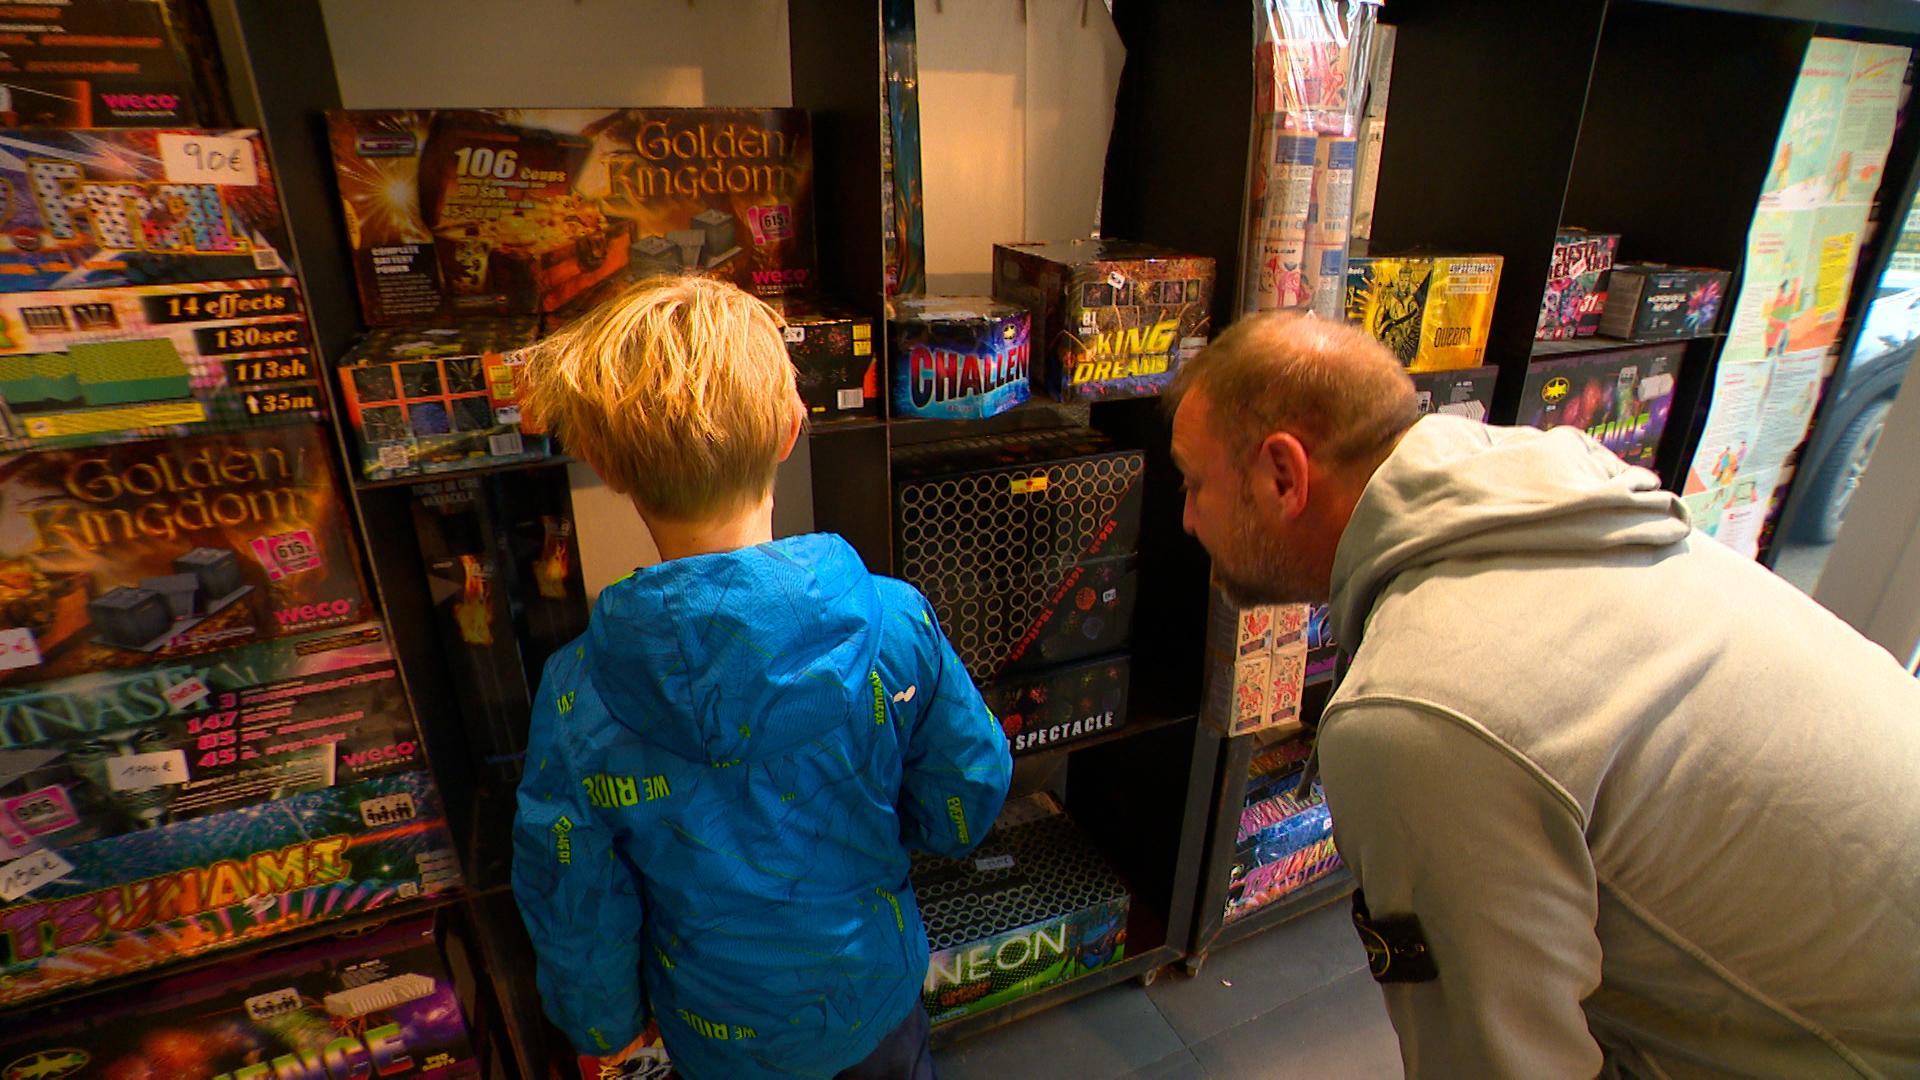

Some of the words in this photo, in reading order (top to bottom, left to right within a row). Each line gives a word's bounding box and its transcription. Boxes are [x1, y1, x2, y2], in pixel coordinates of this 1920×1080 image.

[635, 120, 786, 160] Golden
[454, 147, 518, 179] 106
[168, 297, 199, 318] 14
[205, 292, 286, 319] effects
[215, 327, 299, 349] 130sec
[1096, 317, 1183, 356] KING
[234, 358, 308, 383] 113sh
[65, 446, 293, 502] Golden
[273, 598, 350, 625] weco
[1015, 711, 1115, 752] SPECTACLE
[342, 740, 416, 768] weco
[641, 775, 671, 801] WE
[926, 921, 1067, 993] NEON
